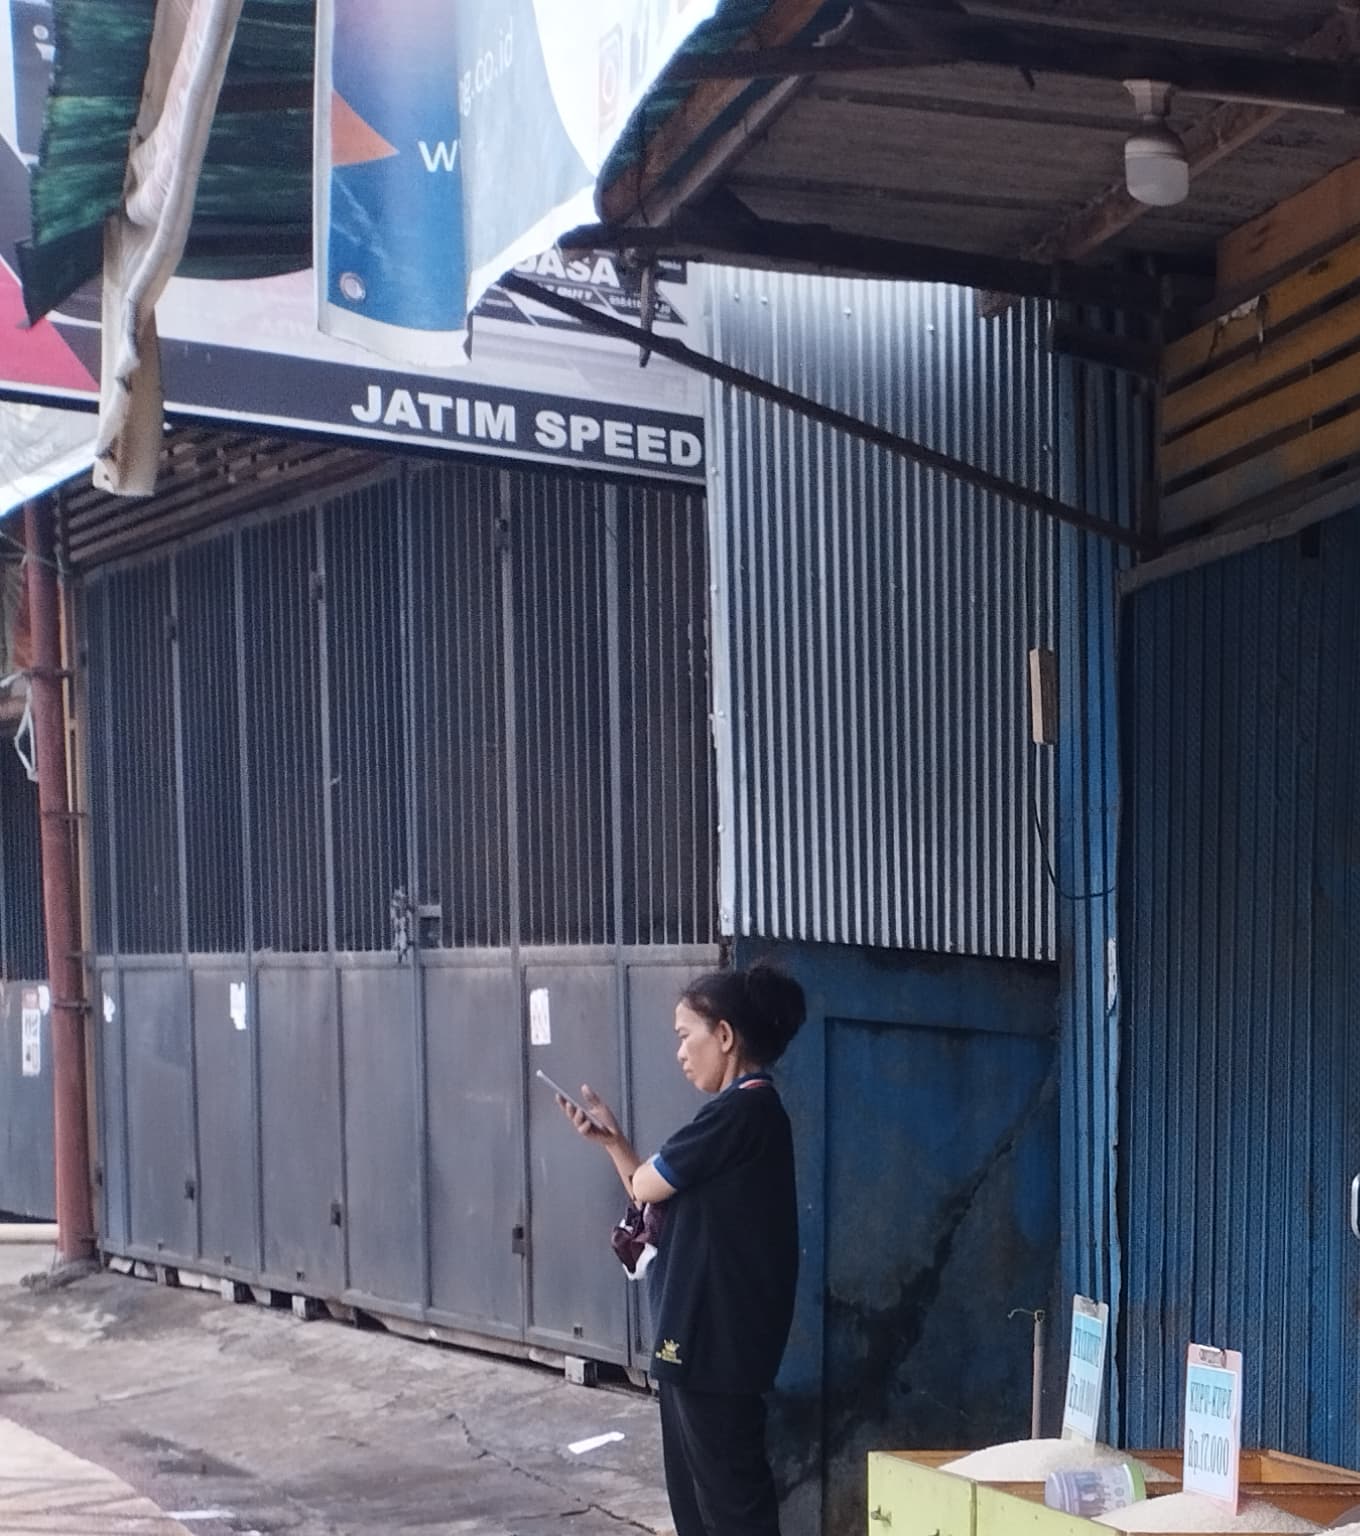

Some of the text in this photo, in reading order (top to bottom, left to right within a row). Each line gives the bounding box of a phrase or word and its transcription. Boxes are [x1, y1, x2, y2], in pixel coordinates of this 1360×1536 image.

[418, 140, 461, 172] w
[351, 385, 701, 467] JATIM SPEED
